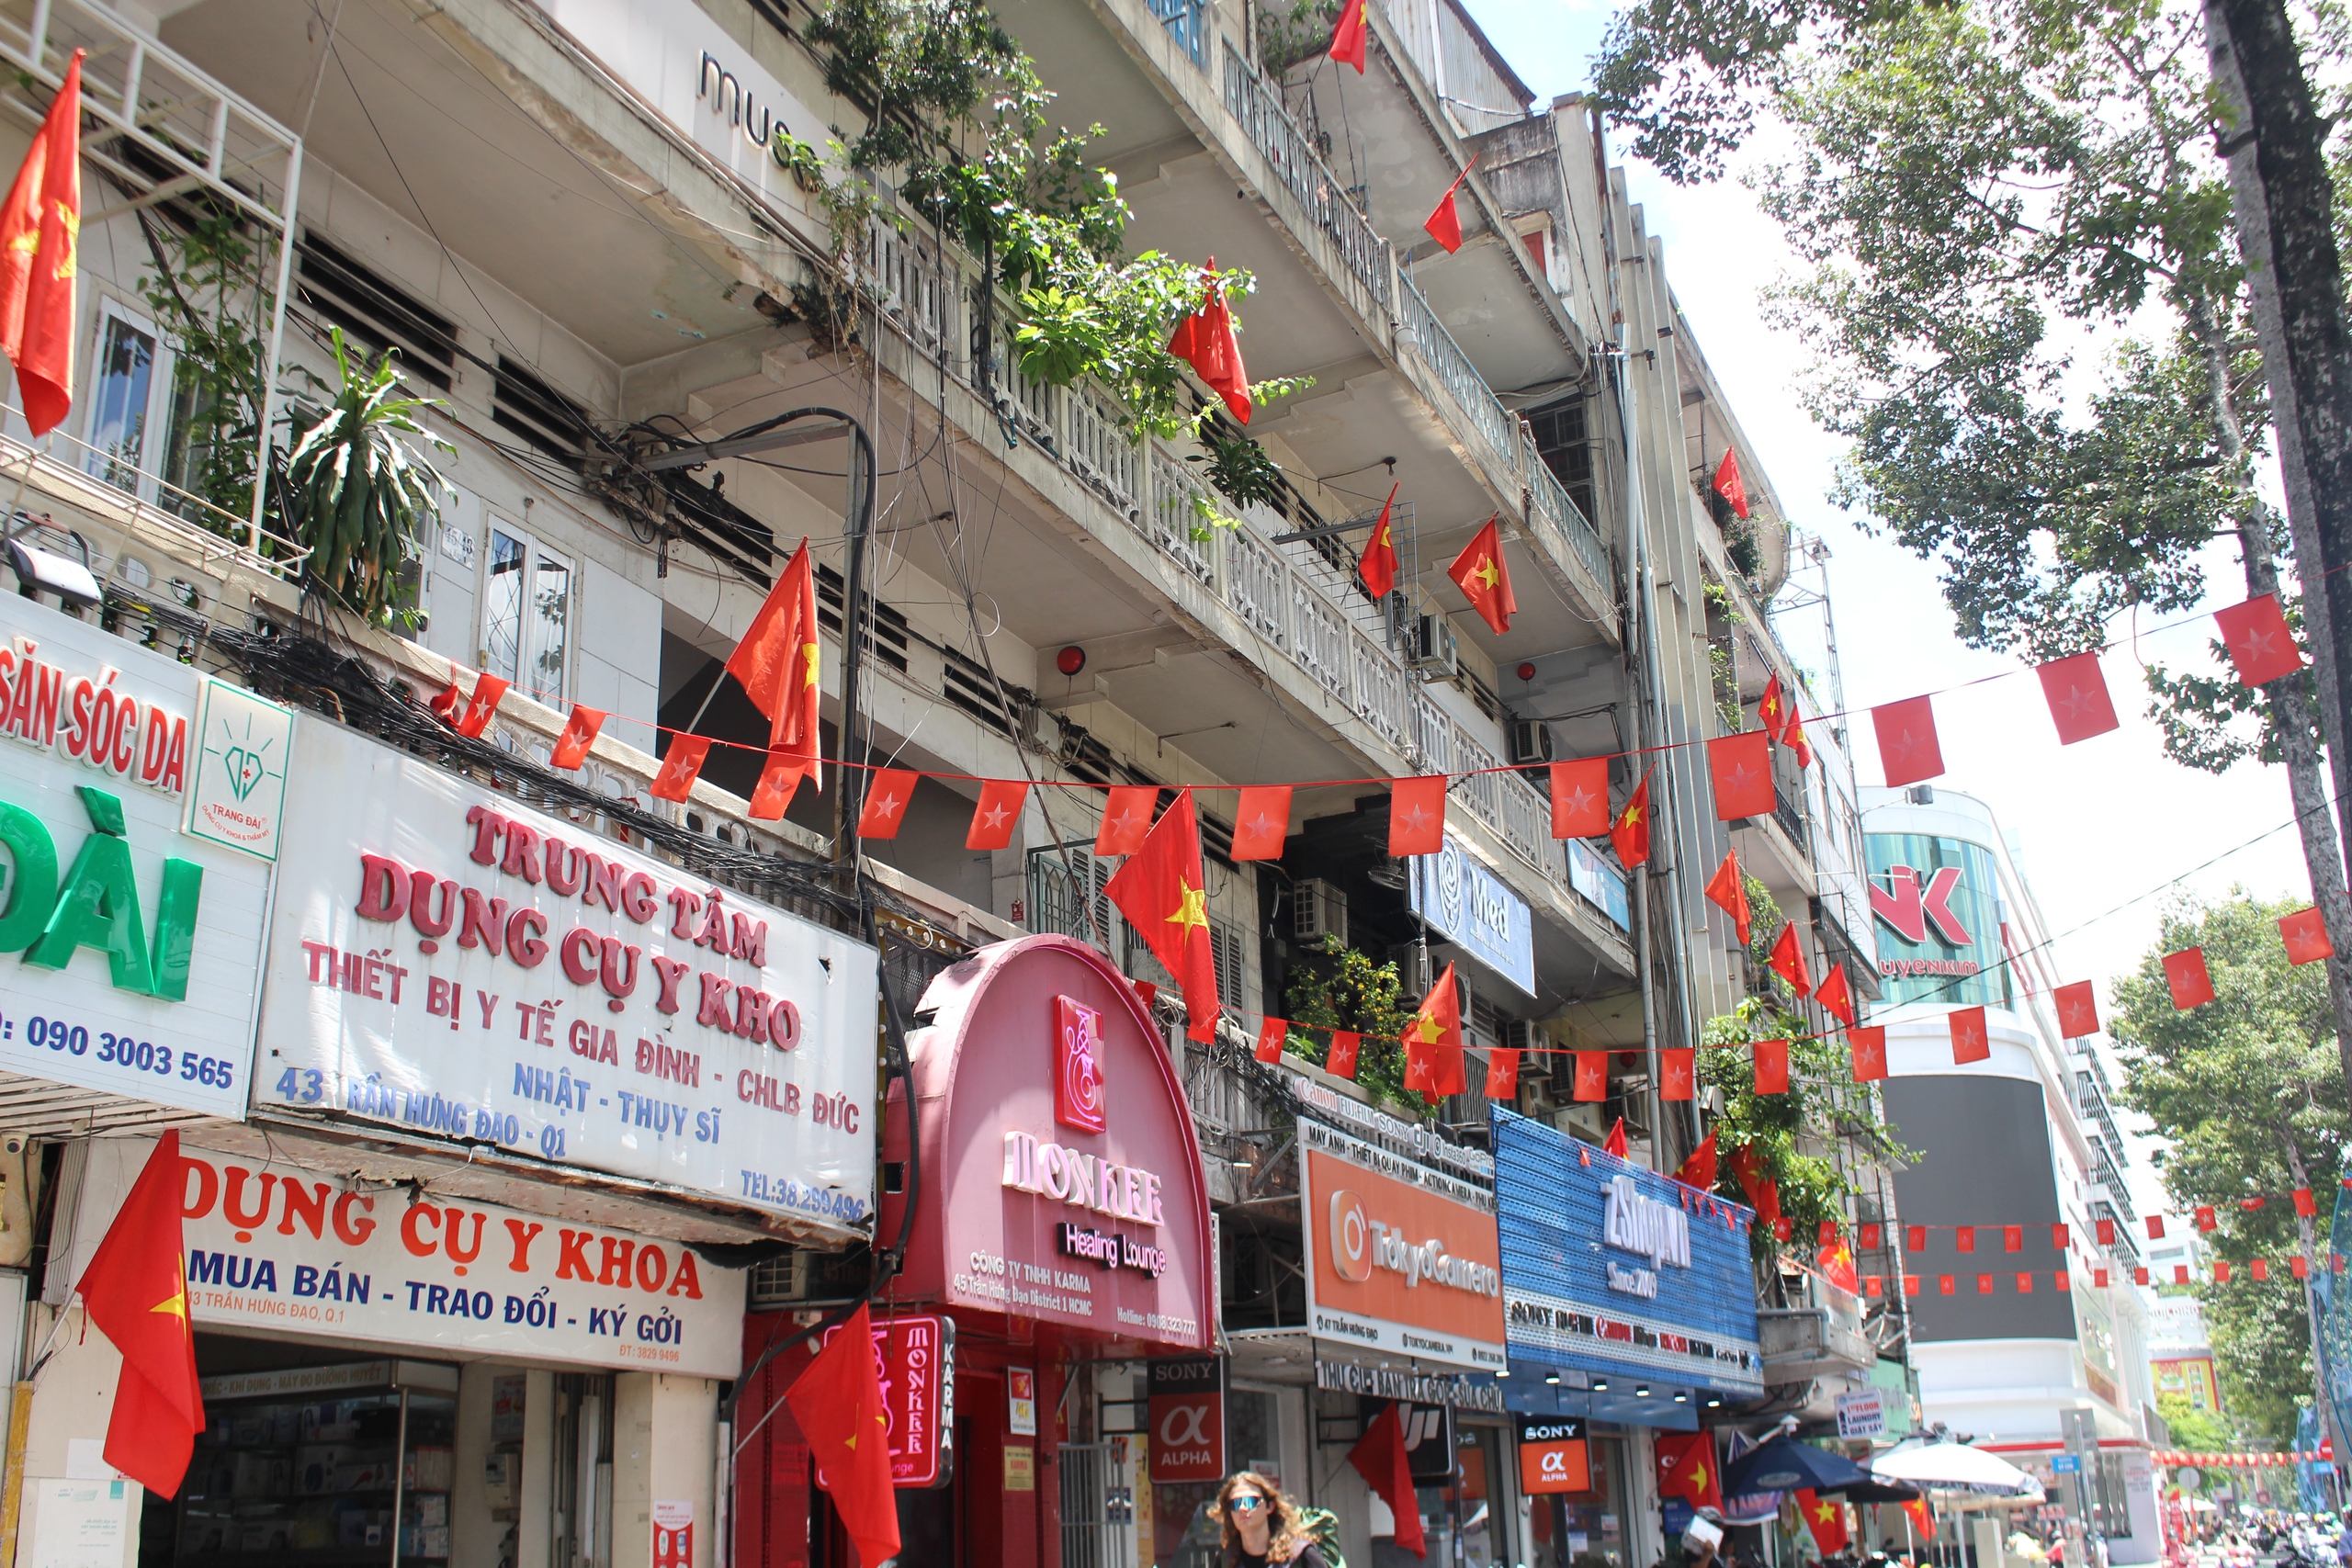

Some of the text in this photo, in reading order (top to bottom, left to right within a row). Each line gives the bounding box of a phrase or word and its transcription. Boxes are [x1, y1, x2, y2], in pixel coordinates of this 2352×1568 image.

[58, 665, 139, 776] SÓC
[134, 704, 187, 797] DA
[212, 804, 261, 829] TRANG ĐÀI
[226, 829, 241, 840] KHOA
[467, 805, 768, 968] TRUNG TÂM
[1471, 869, 1510, 943] Med
[355, 853, 801, 1052] DỤNG CỤ Y KHO
[28, 1016, 88, 1056] 090
[96, 1032, 173, 1075] 3003
[181, 1052, 233, 1089] 565
[301, 940, 408, 1005] THIẾT
[426, 976, 460, 1031] BỊ
[477, 989, 499, 1031] Y
[516, 998, 563, 1047] TẾ
[569, 1019, 619, 1067] GIA
[635, 1028, 700, 1089] ĐÌNH
[737, 1068, 800, 1117] CHLB
[812, 1086, 859, 1135] ĐỨC
[277, 1067, 322, 1102] 43
[405, 1091, 468, 1135] HƯNG
[540, 1124, 566, 1159] Q1
[514, 1062, 591, 1116] NHẬT
[618, 1089, 688, 1141] THỤY
[695, 1106, 721, 1145] SĨ
[1299, 1078, 1338, 1111] Canon
[1378, 1114, 1408, 1142] SONY
[1469, 1149, 1494, 1168] GoPro
[1002, 1131, 1165, 1227] MONKEE
[1309, 1124, 1326, 1145] MÁY
[1382, 1156, 1400, 1174] QUAY
[1401, 1164, 1419, 1181] PHIM
[179, 1156, 704, 1300] DỤNG CỤ Y KHOA
[1065, 1224, 1167, 1279] Healing Lounge
[970, 1250, 1091, 1293] CÔNG TY TNHH KARMA
[1370, 1220, 1499, 1298] TokyoCamera
[1607, 1261, 1634, 1292] Since
[188, 1249, 277, 1293] MUA
[293, 1262, 370, 1304] BÁN
[405, 1280, 493, 1320] TRAO
[504, 1286, 557, 1329] ĐỔI
[589, 1303, 628, 1337] KÝ
[637, 1306, 682, 1345] GỞI
[206, 1290, 243, 1311] TRẦN
[247, 1297, 286, 1316] HƯNG
[325, 1309, 345, 1323] Q.1
[954, 1274, 1092, 1316] 45 Trần Hưng Đạo District 1 HCMC
[1117, 1307, 1196, 1336] Hotline: 0908 323 777
[1510, 1301, 1552, 1326] SONY
[1324, 1318, 1331, 1331] 47
[1332, 1316, 1348, 1334] TRẦN
[637, 1346, 657, 1359] 3829
[659, 1348, 679, 1362] 9496
[1155, 1362, 1214, 1382] SONY
[230, 1380, 245, 1393] KHÍ
[247, 1378, 271, 1392] DUNG
[278, 1374, 298, 1389] MÁY
[906, 1327, 928, 1455] MONKEE
[942, 1344, 955, 1450] KARMA
[1525, 1425, 1577, 1439] SONY
[1848, 1413, 1881, 1426] LAUNDRY
[1161, 1450, 1212, 1465] ALPHA
[1541, 1472, 1567, 1483] ALPHA
